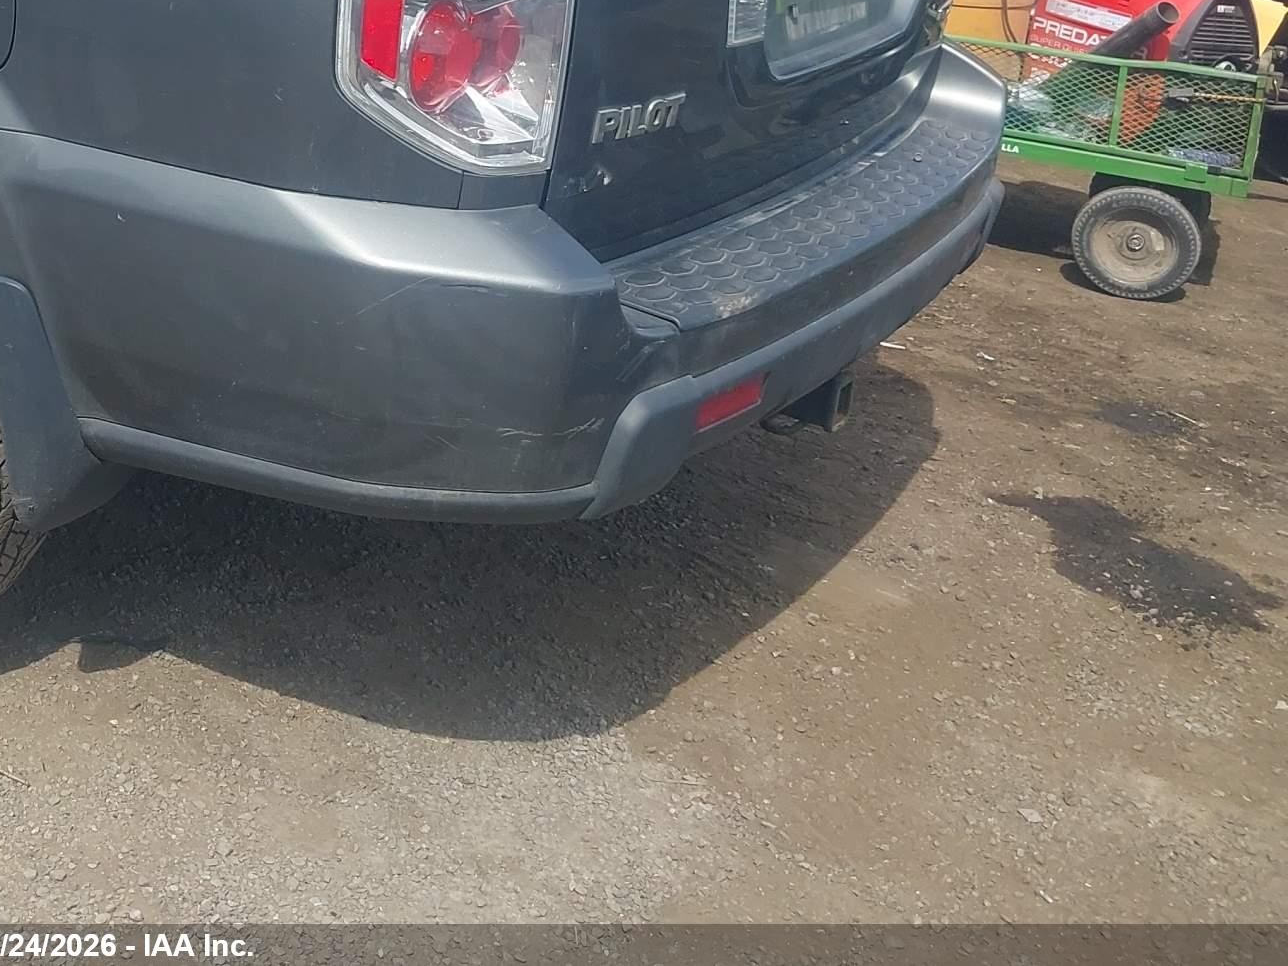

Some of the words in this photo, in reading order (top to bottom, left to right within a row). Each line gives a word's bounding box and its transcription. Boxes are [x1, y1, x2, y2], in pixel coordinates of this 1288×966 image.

[1030, 33, 1061, 49] SUPER
[1032, 16, 1109, 46] PREDA
[591, 92, 687, 144] PILOT
